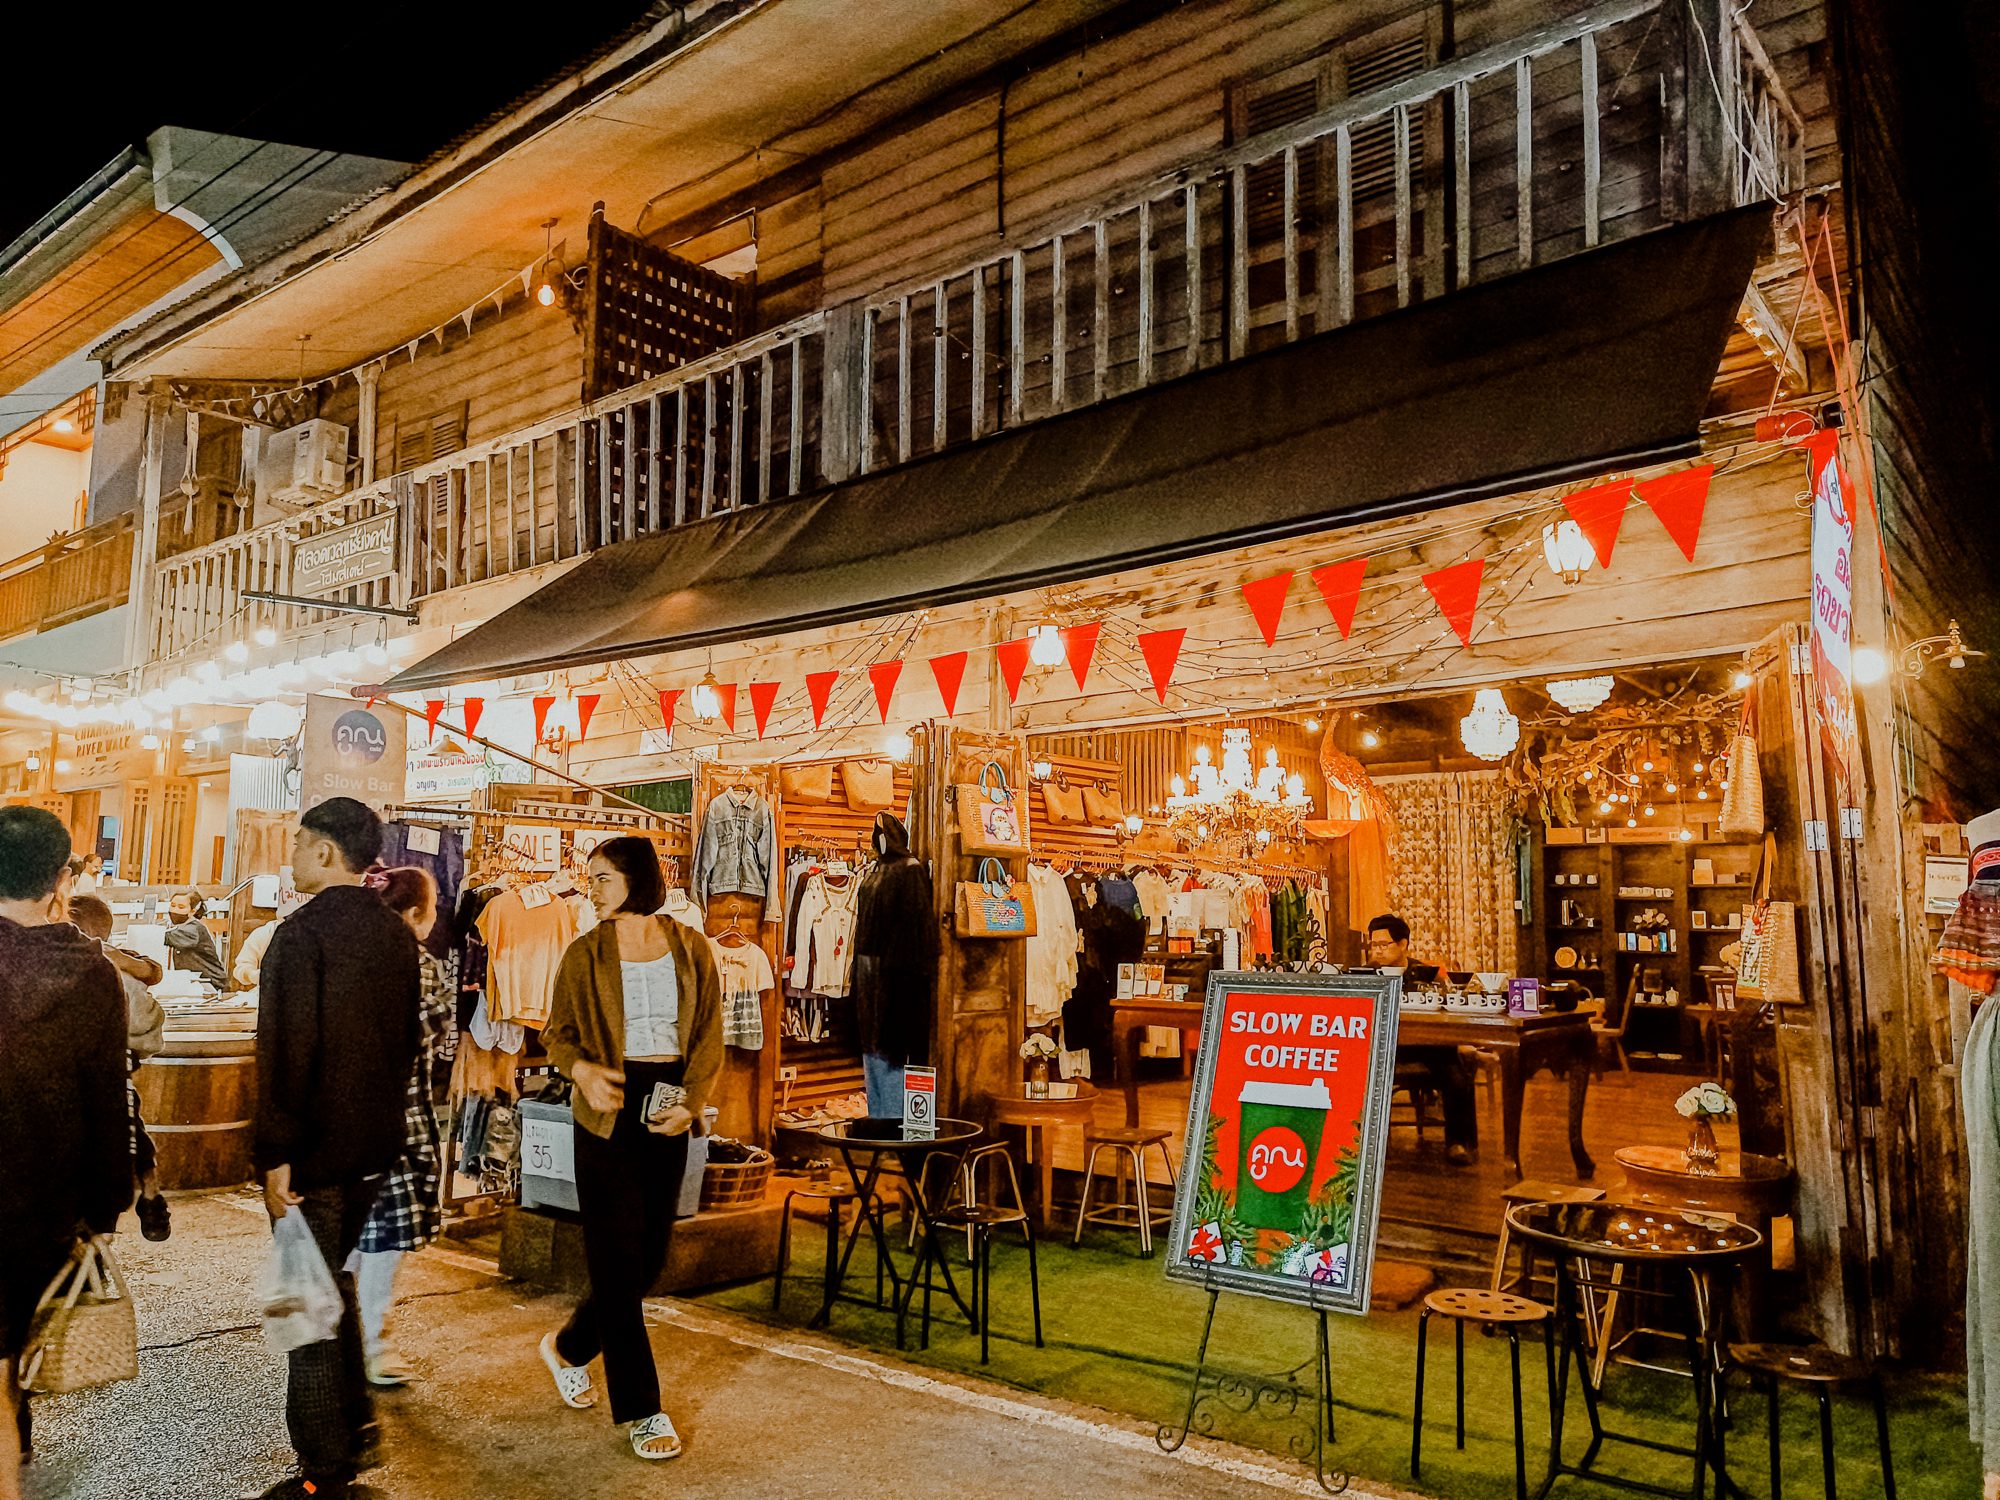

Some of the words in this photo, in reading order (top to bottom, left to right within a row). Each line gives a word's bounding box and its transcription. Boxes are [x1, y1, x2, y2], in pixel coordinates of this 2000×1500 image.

[76, 741, 103, 757] RIVER
[105, 735, 131, 753] WALK
[323, 773, 364, 791] Slow
[367, 777, 395, 792] Bar
[506, 833, 553, 863] SALE
[1230, 1011, 1303, 1035] SLOW
[1309, 1014, 1367, 1039] BAR
[1244, 1044, 1340, 1072] COFFEE
[1250, 1144, 1304, 1180] คุณ
